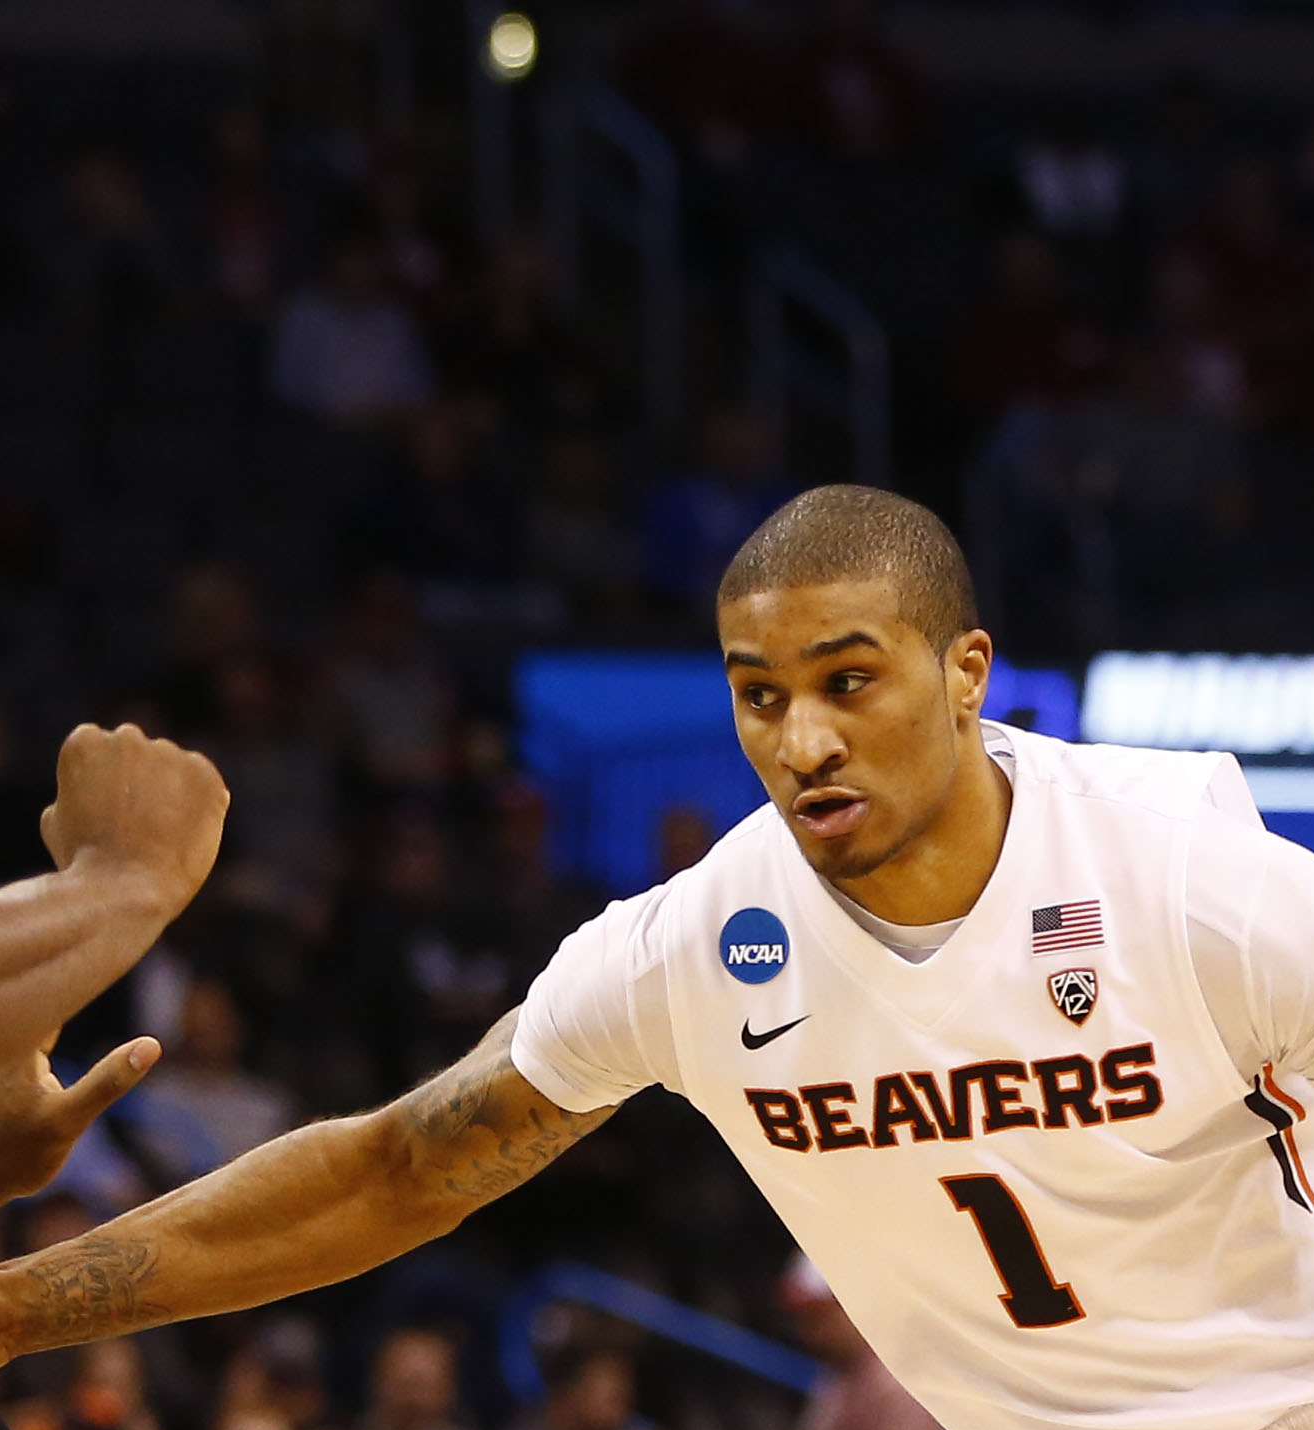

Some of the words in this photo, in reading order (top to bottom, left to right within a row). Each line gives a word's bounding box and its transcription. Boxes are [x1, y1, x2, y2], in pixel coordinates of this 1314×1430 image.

[727, 943, 785, 965] NCAA
[1050, 970, 1096, 1007] PAC
[1064, 993, 1089, 1016] 12
[743, 1042, 1164, 1153] BEAVERS
[938, 1173, 1087, 1329] 1
